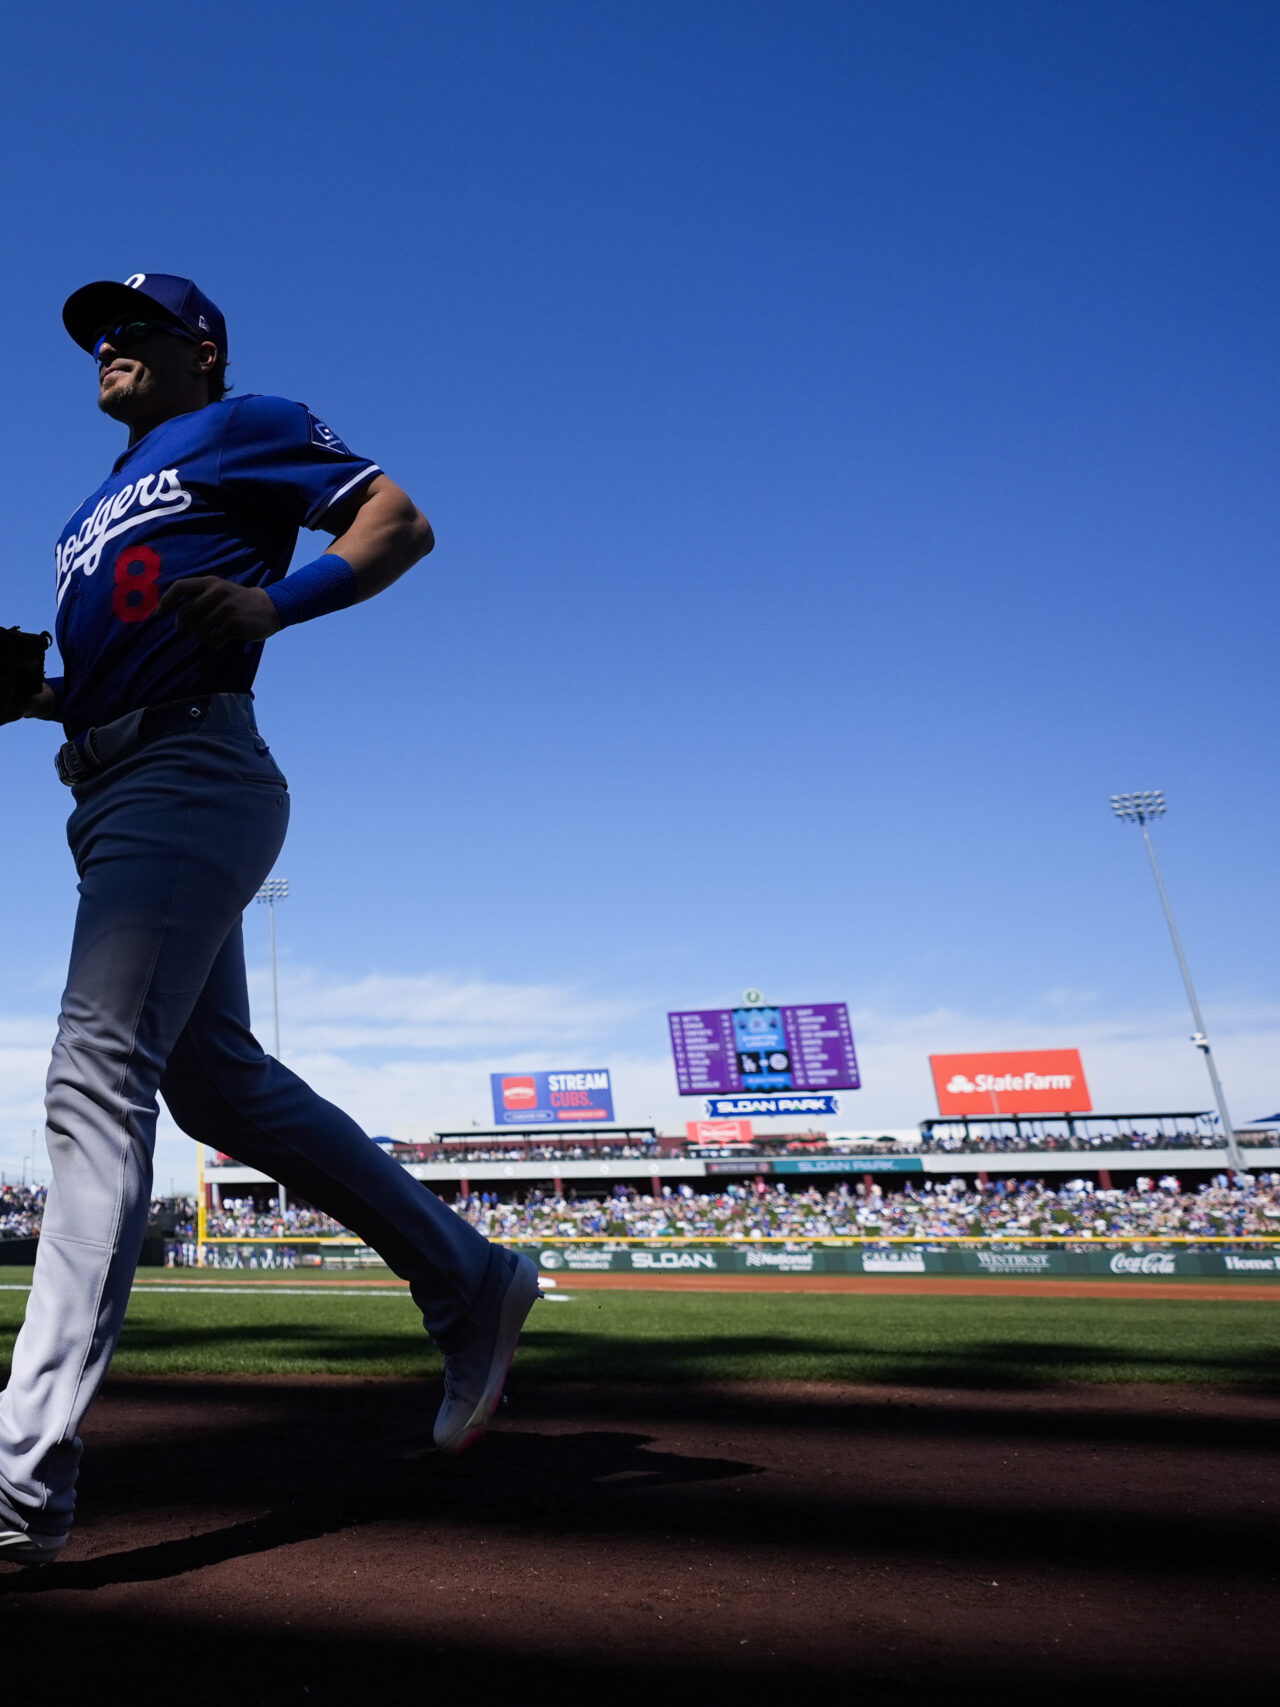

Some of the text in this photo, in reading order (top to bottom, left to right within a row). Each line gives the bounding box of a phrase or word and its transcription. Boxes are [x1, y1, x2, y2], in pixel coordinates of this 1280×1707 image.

[113, 545, 161, 623] 8
[548, 1072, 608, 1092] STREAM
[715, 1098, 827, 1114] SLOAN PARK
[797, 1160, 896, 1172] SLOAN PARK
[631, 1252, 715, 1269] SLOAN
[1224, 1256, 1274, 1270] Home
